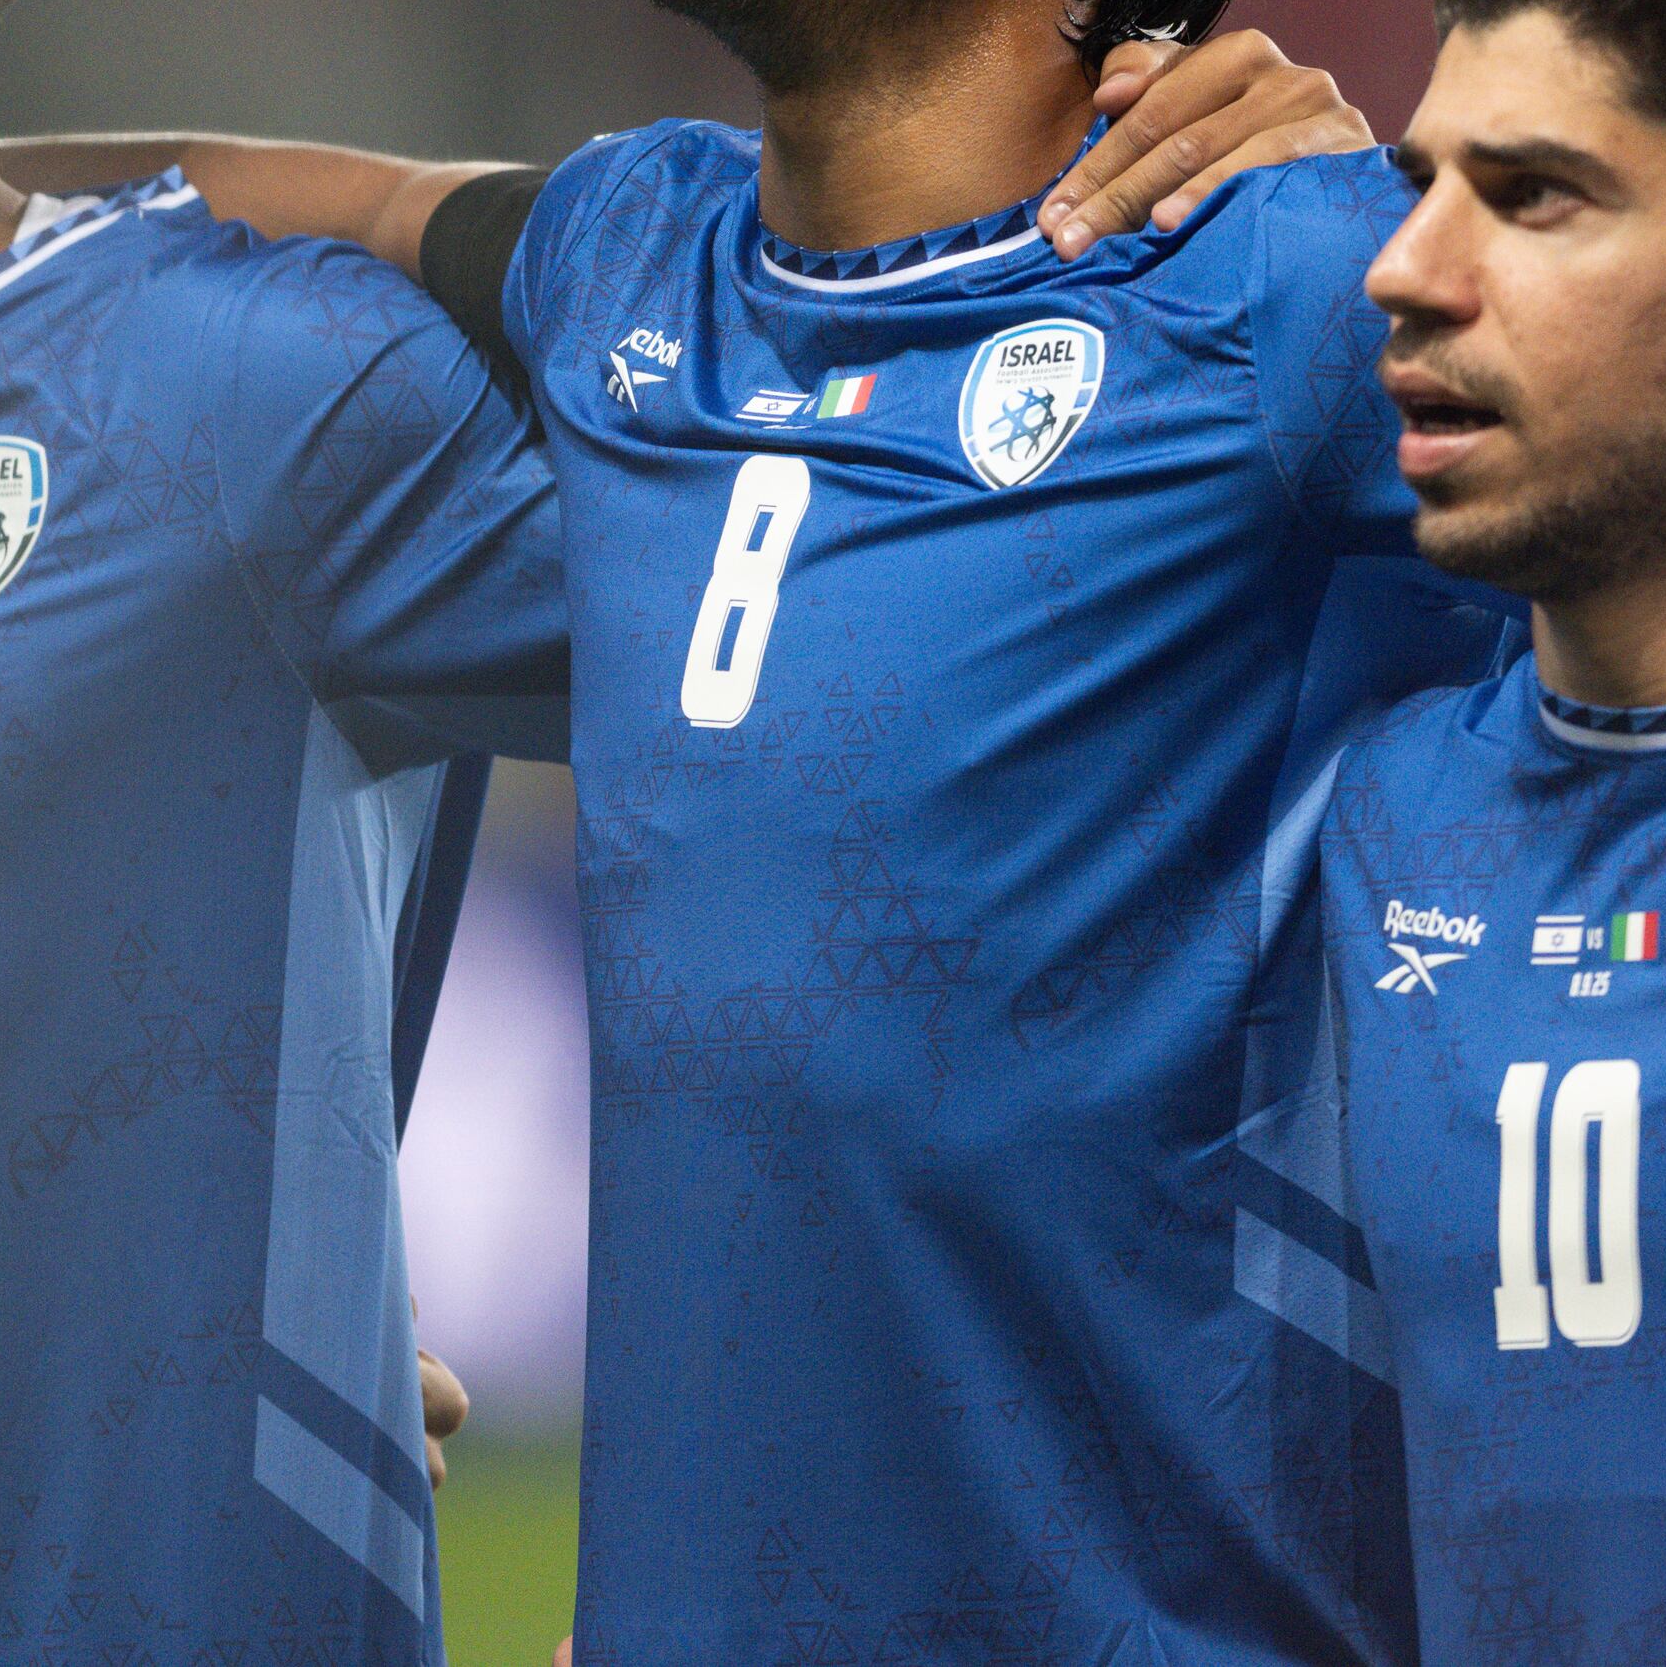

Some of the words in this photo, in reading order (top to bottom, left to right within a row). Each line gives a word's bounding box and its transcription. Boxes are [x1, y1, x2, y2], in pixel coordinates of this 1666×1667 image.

[1000, 339, 1076, 368] ISRAEL
[680, 454, 811, 729] 8
[1383, 899, 1488, 946] Reebok
[1494, 1059, 1643, 1351] 10
